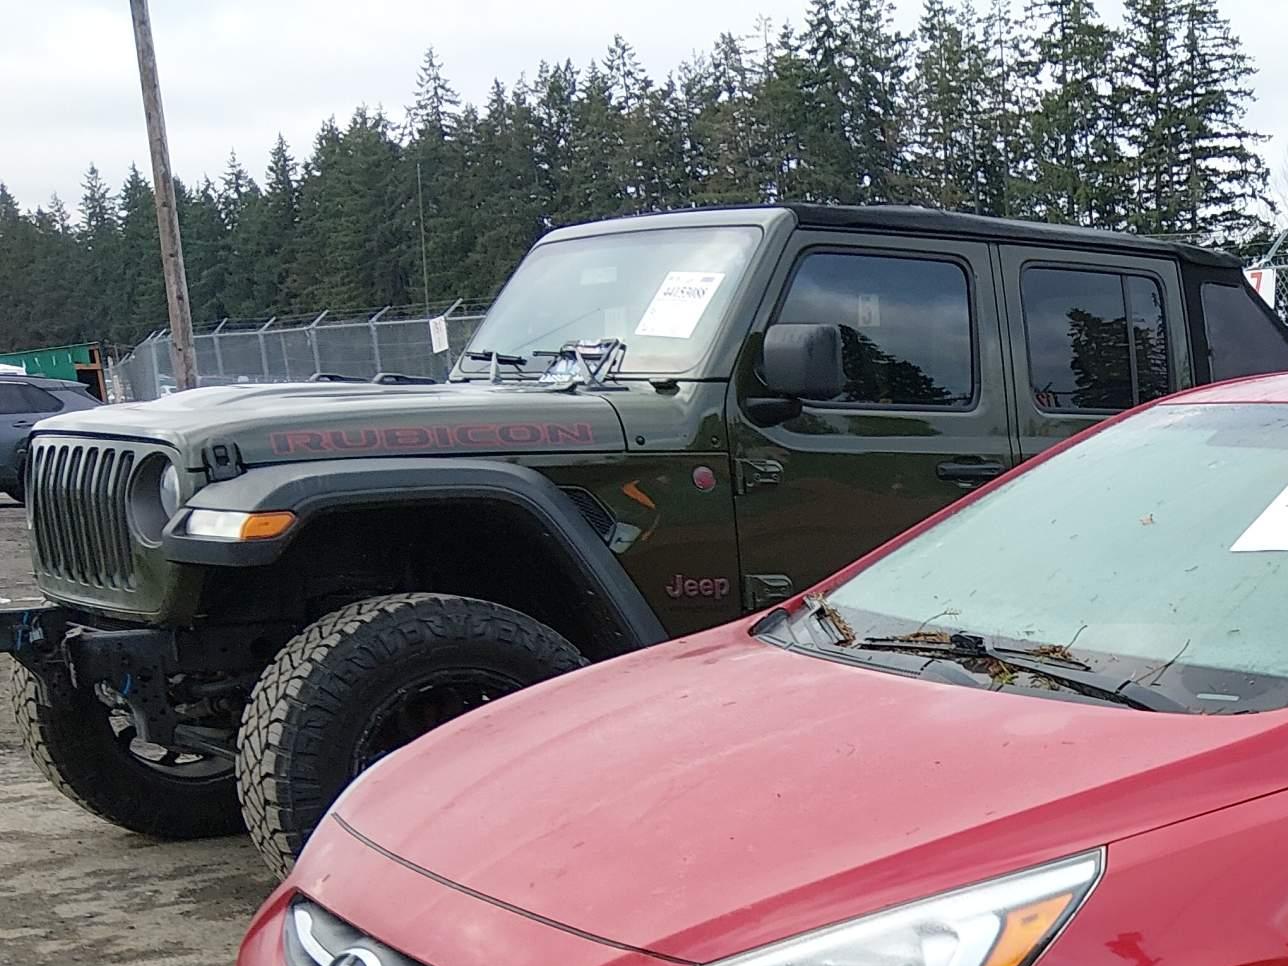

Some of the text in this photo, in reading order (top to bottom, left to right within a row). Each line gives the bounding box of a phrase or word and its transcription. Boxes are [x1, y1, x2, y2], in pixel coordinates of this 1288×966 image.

[1250, 271, 1263, 294] 7
[270, 422, 593, 455] RUBICON
[665, 574, 731, 600] Jeep
